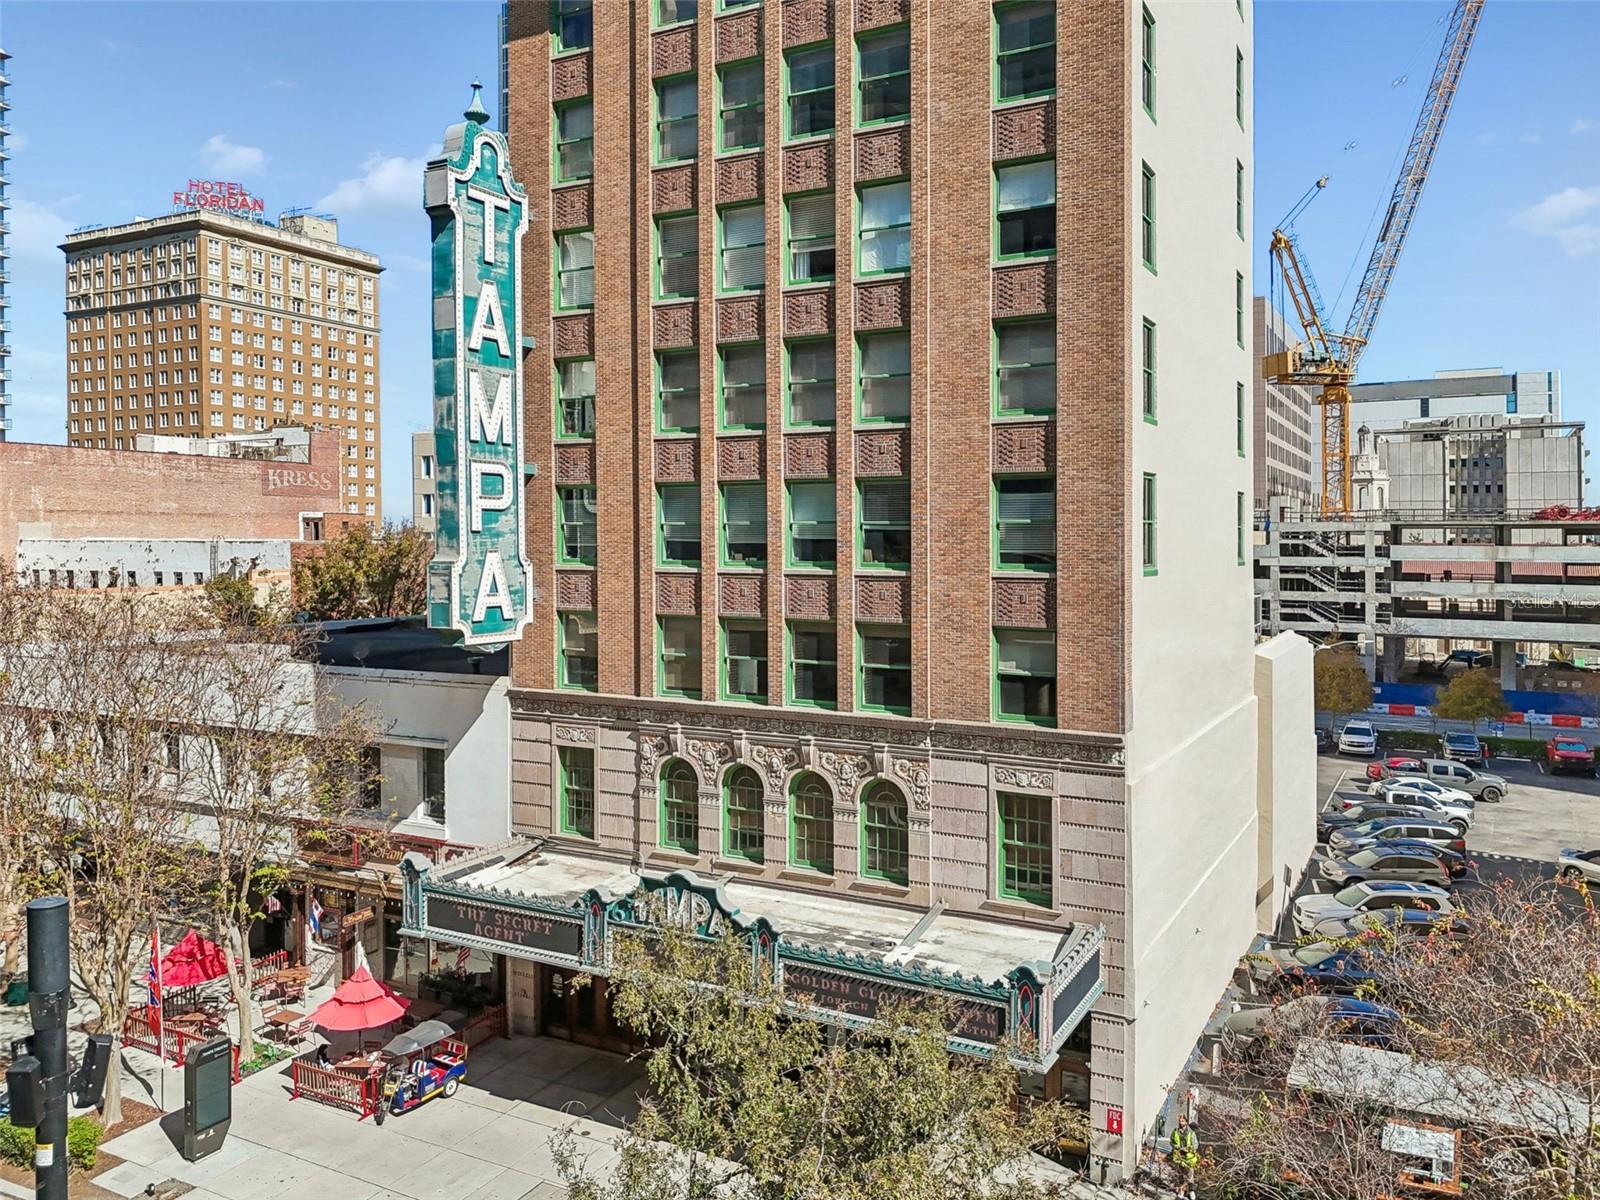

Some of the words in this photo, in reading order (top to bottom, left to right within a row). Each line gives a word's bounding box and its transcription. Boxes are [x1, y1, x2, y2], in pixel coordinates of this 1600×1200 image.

[188, 179, 249, 196] HOTEL
[173, 192, 264, 211] FLORIDAN
[467, 184, 514, 624] TAMPA
[268, 469, 332, 490] KRESS
[494, 913, 552, 935] SECRET
[791, 973, 850, 993] GOLDEN
[1110, 1111, 1121, 1120] FDC
